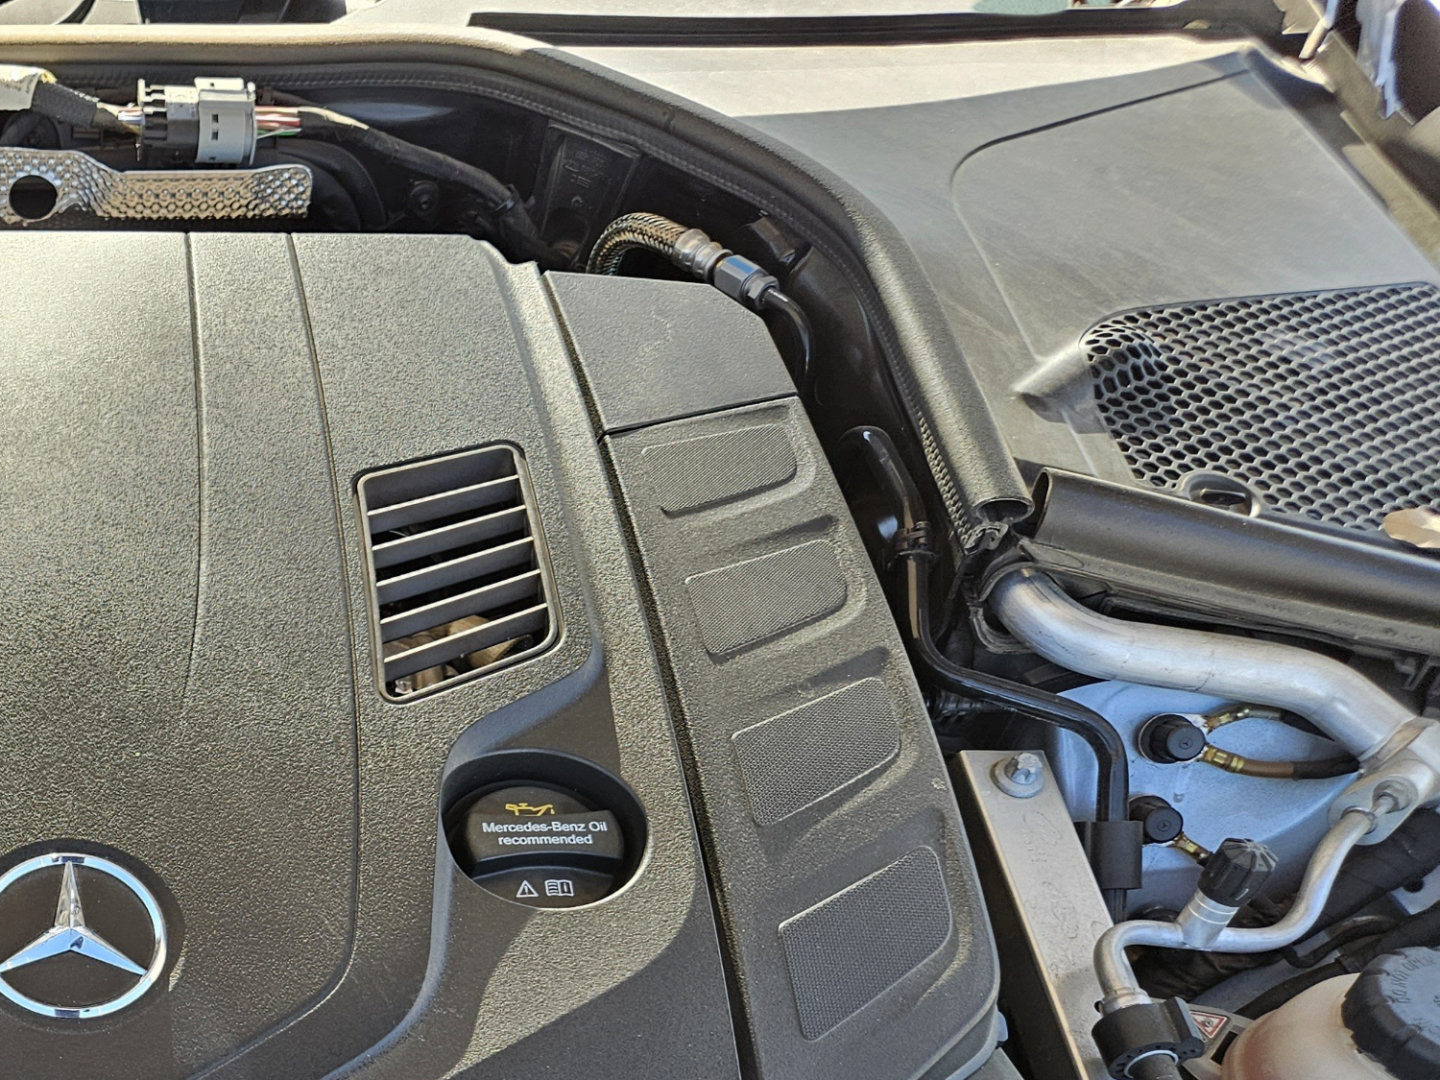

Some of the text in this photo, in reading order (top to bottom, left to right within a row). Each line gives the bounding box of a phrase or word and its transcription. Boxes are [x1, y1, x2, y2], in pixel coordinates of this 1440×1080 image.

[482, 821, 608, 833] Mercedes-Benz Oil
[498, 834, 593, 845] recommended
